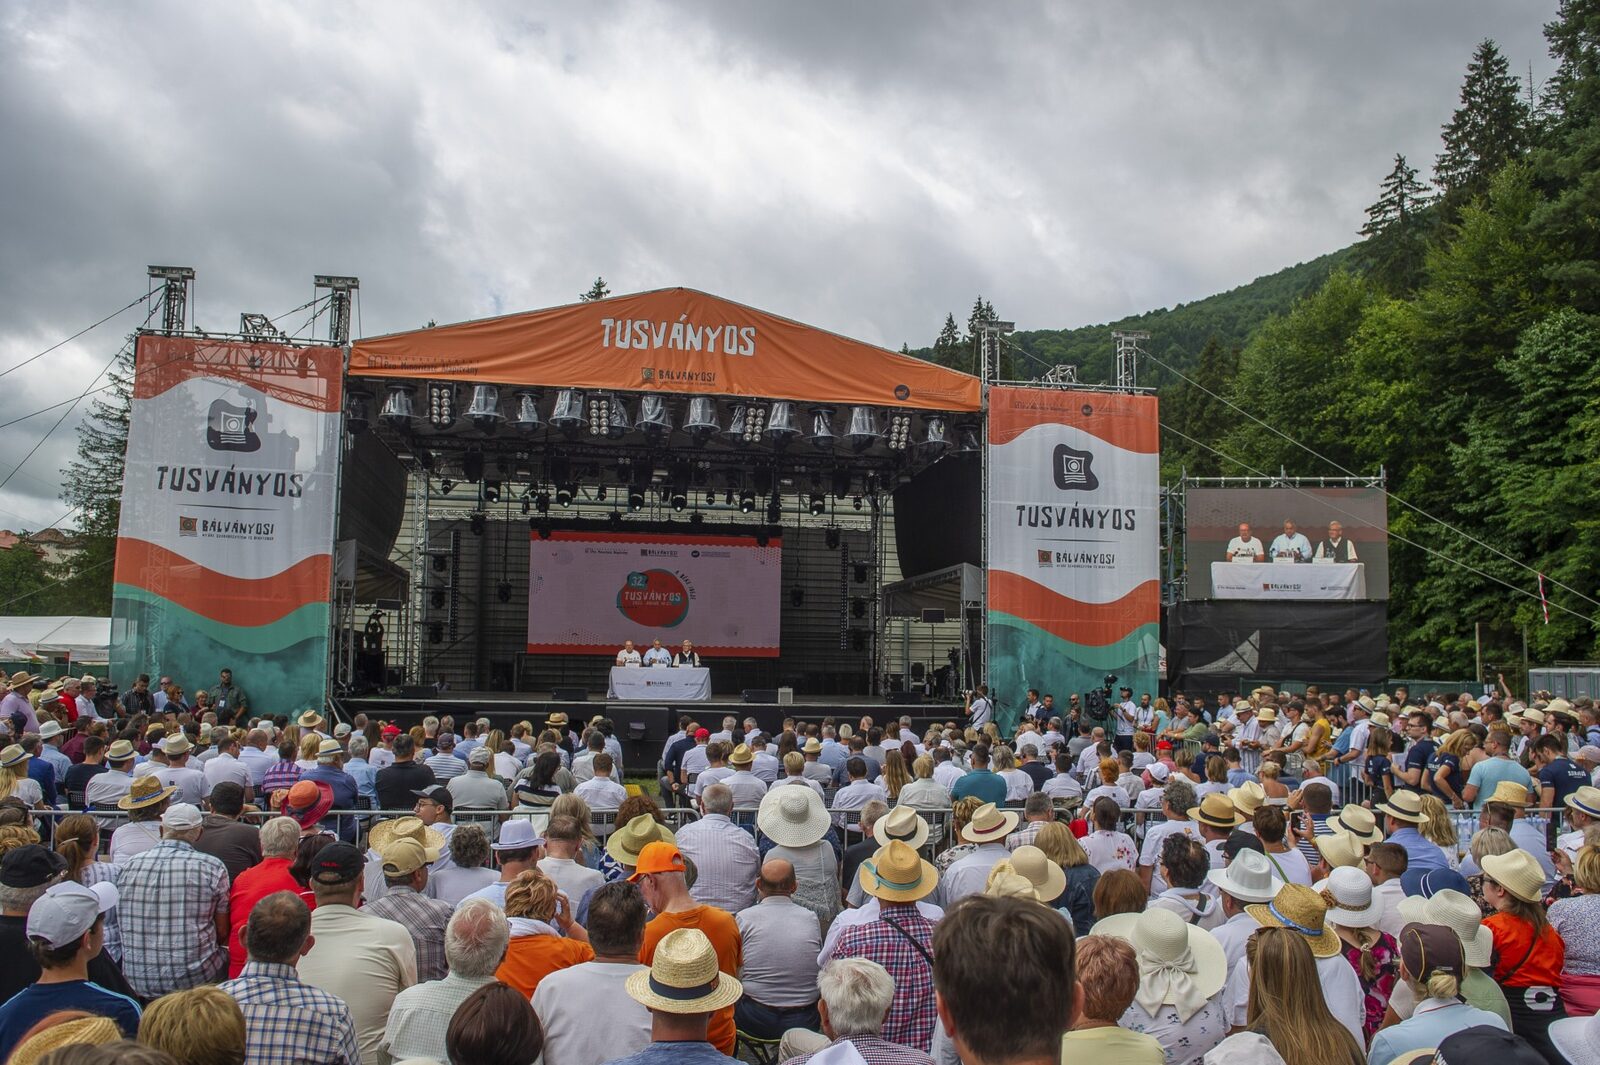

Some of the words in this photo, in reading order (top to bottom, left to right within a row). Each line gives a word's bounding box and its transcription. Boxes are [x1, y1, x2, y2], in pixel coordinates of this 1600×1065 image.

[601, 313, 756, 357] TUSVÁNYOS
[658, 367, 716, 382] BÁLVÁNYOSI
[157, 464, 304, 498] TUSVÁNYOS
[1016, 501, 1136, 531] TUSVÁNYOS
[202, 518, 274, 535] BÁLVÁNYOSI
[1056, 550, 1115, 564] BÁLVÁNYOSI
[624, 589, 681, 602] TUSVÁNYOS
